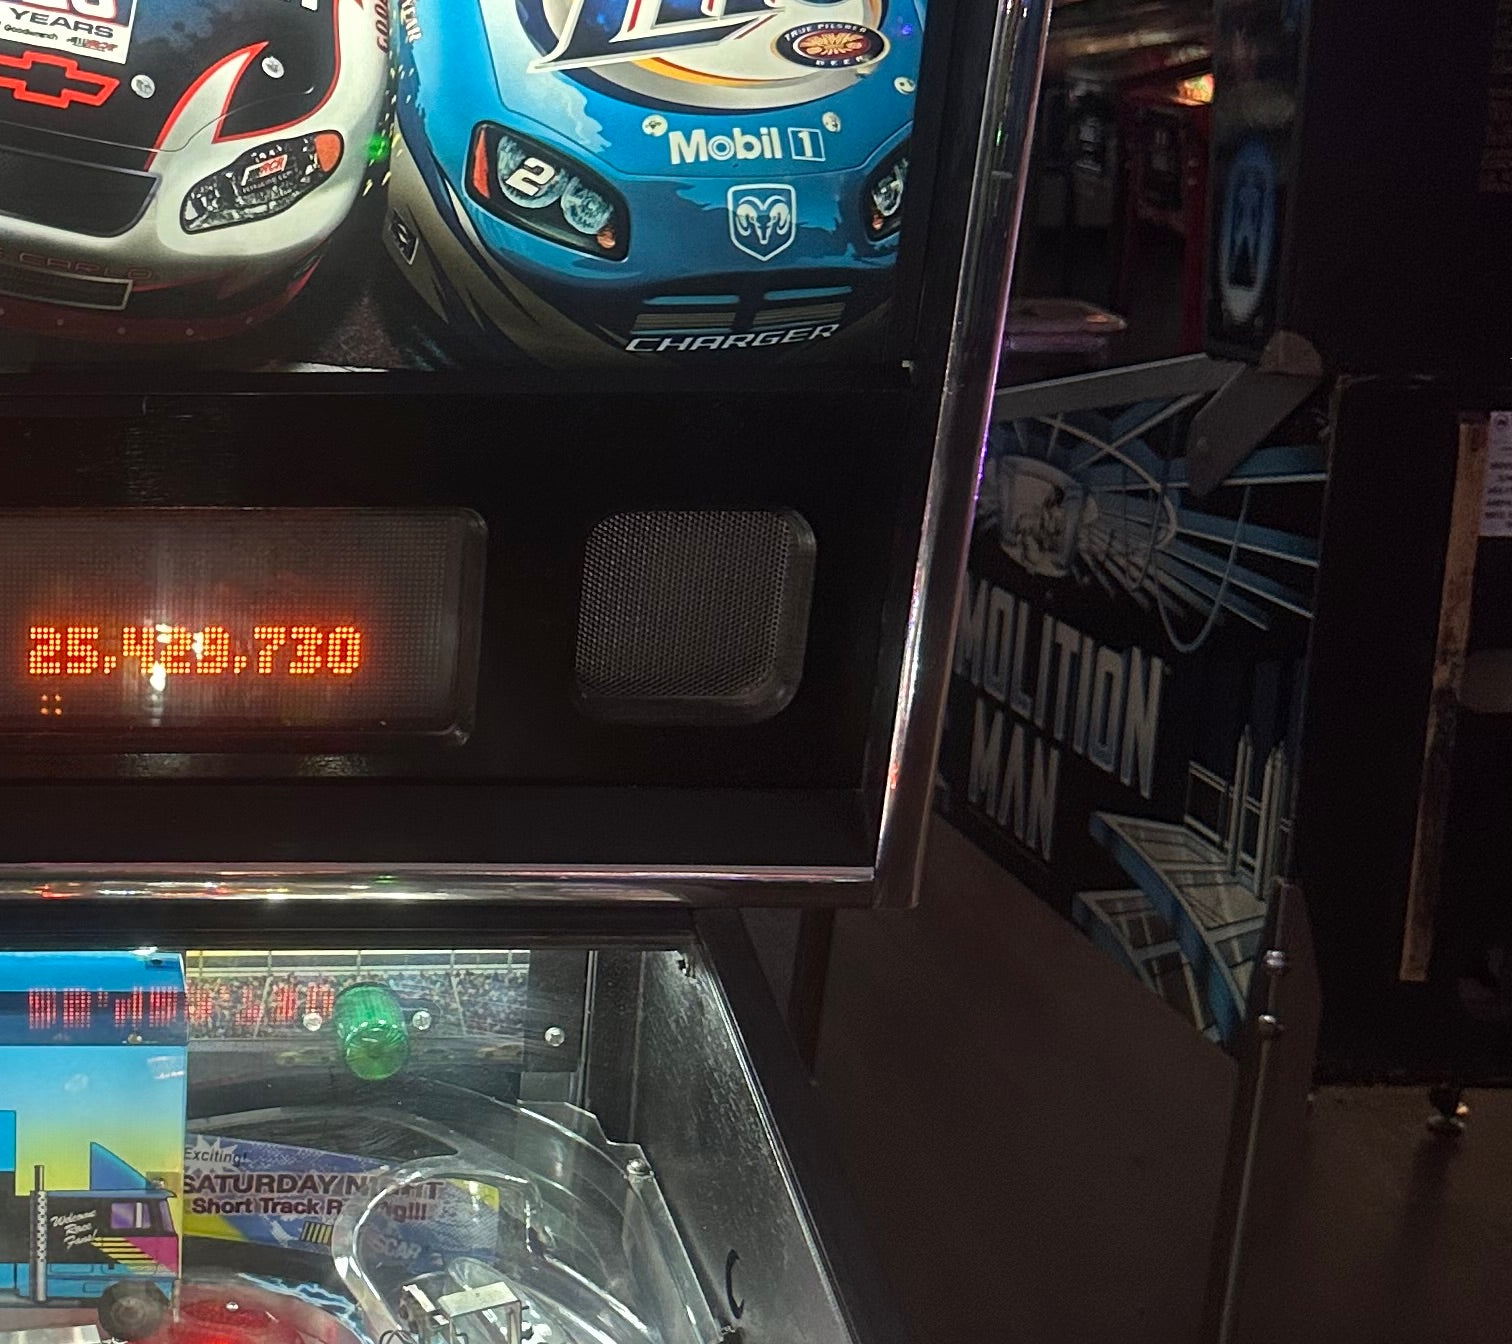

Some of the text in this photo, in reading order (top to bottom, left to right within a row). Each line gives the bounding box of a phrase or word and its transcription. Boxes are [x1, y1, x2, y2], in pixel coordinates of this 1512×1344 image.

[10, 6, 114, 39] YEARS
[785, 26, 813, 41] TRUE
[669, 125, 783, 166] Mobil
[505, 157, 555, 196] 2
[19, 254, 153, 281] CARLO
[625, 323, 839, 353] CHARGER
[968, 701, 1061, 862] MAN
[183, 1174, 338, 1194] SATURDAY
[192, 1197, 321, 1216] Short Track
